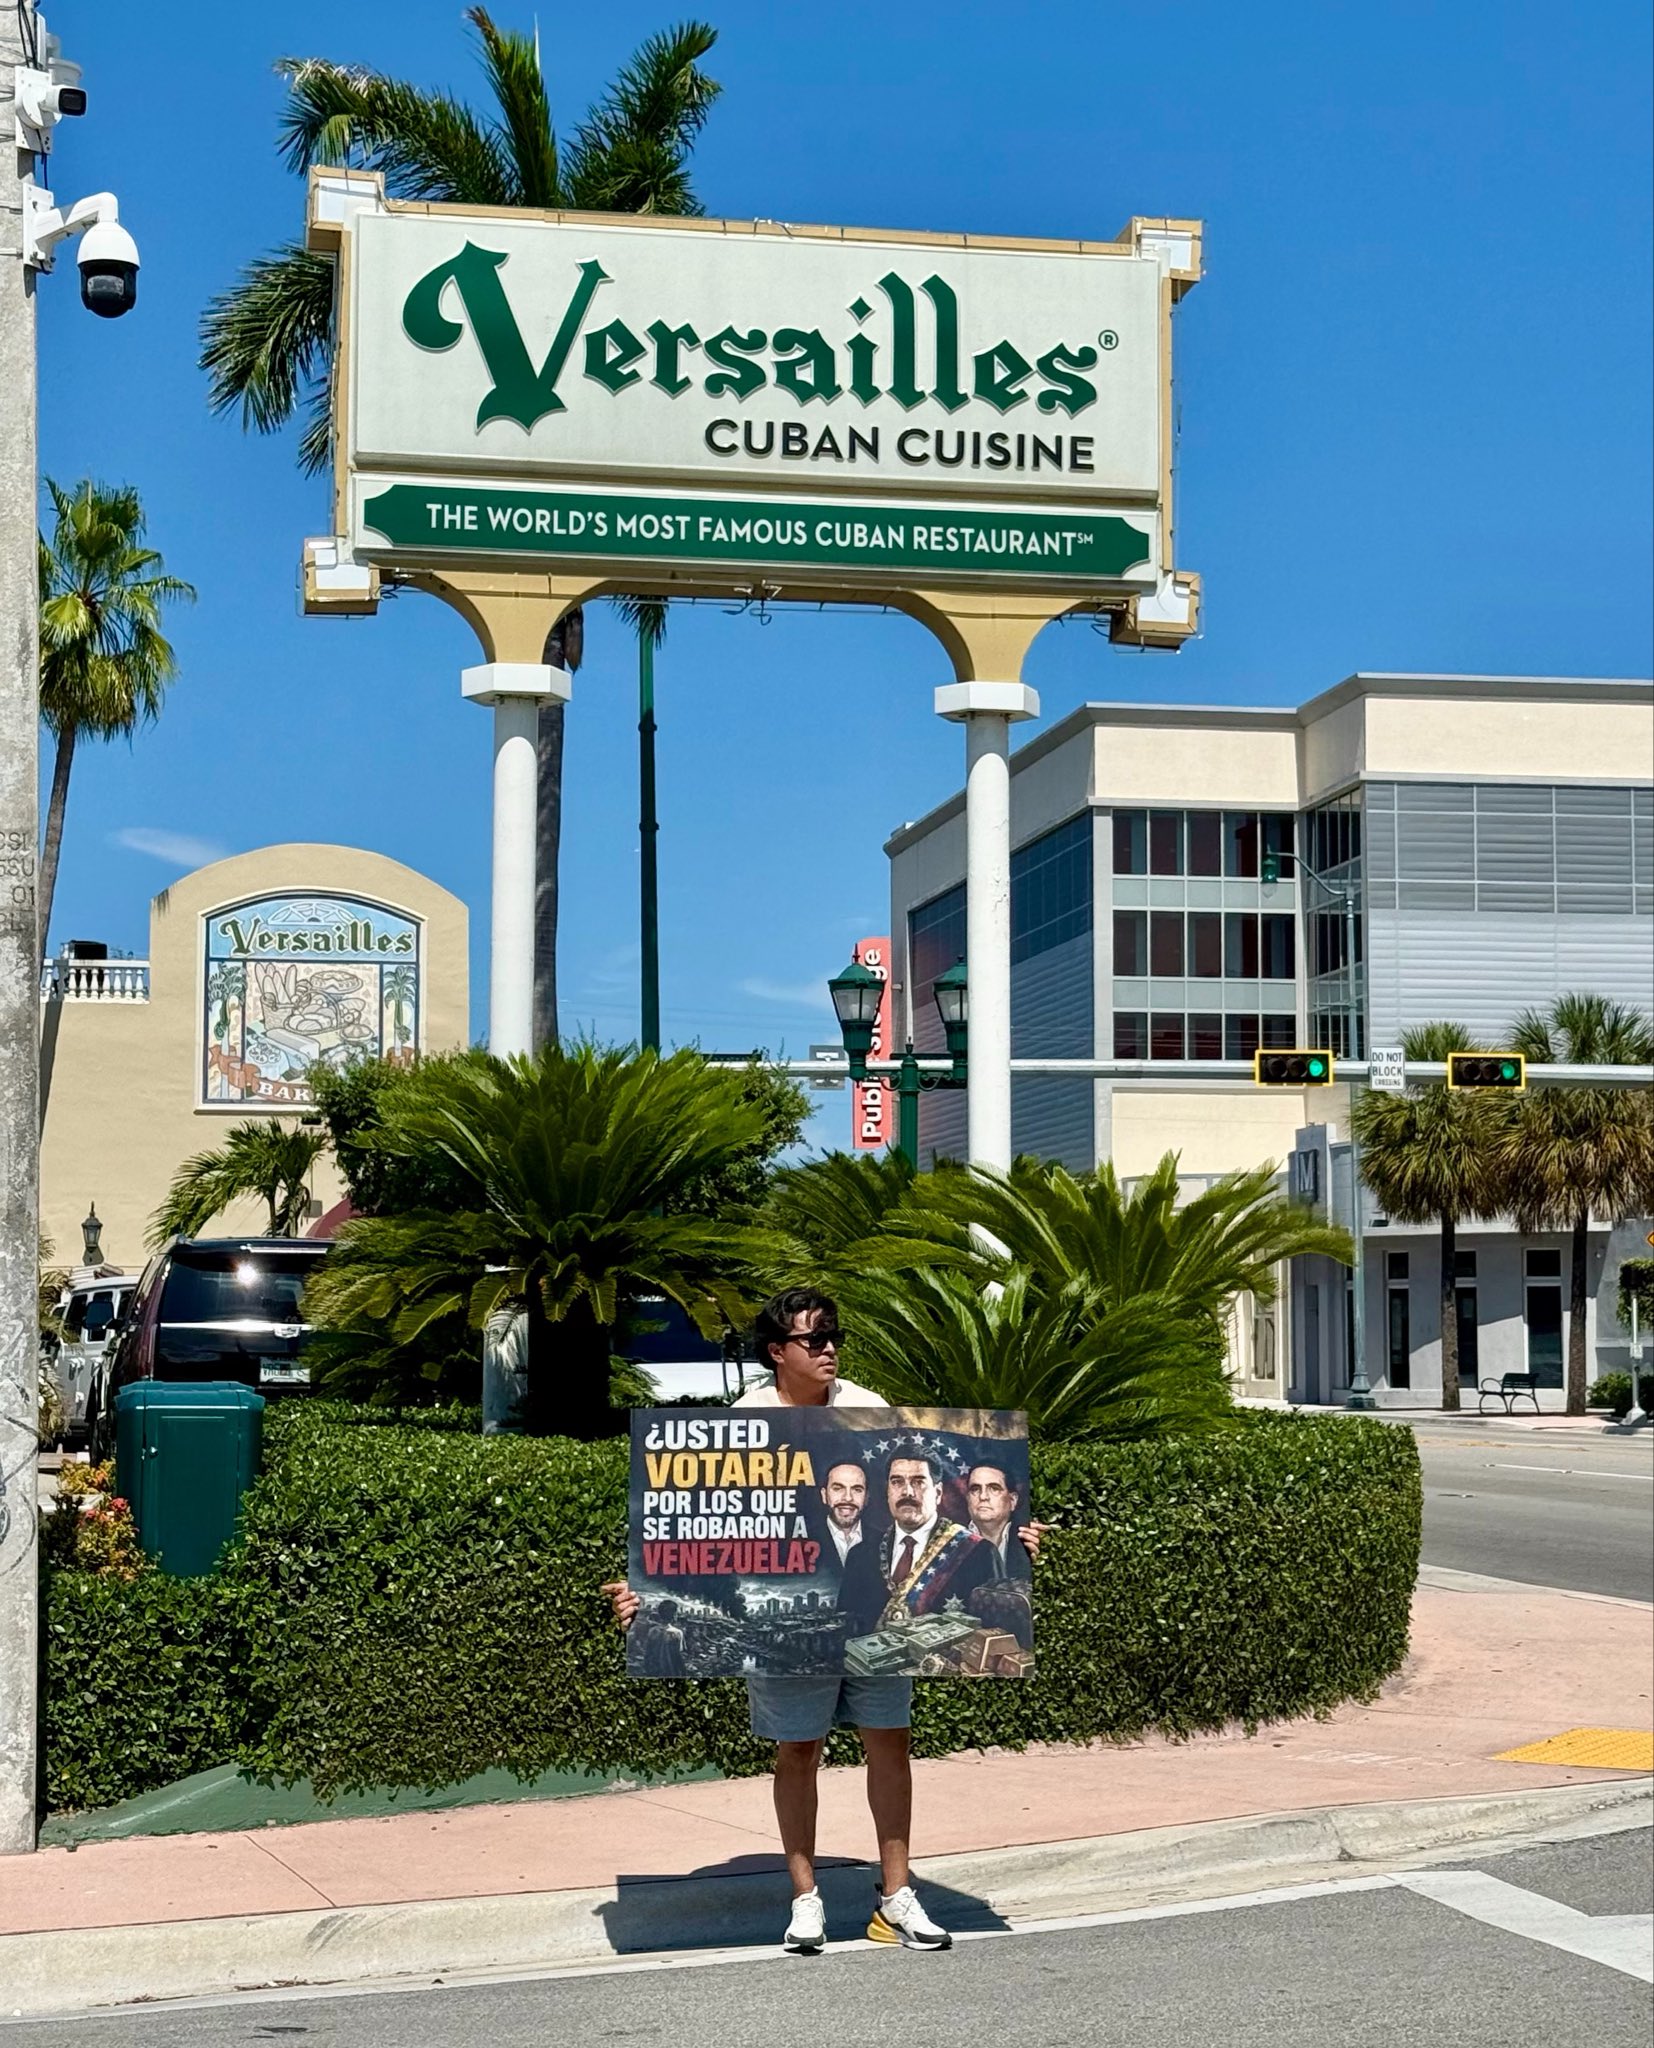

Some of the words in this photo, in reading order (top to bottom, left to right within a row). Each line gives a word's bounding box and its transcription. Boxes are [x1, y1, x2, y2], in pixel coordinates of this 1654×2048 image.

[402, 239, 1098, 435] Versailles
[704, 418, 880, 463] CUBAN
[897, 428, 1095, 473] CUISINE
[426, 503, 478, 530] THE
[487, 506, 608, 536] WORLD'S
[616, 513, 690, 540] MOST
[699, 516, 807, 545] FAMOUS
[815, 521, 904, 550] CUBAN
[219, 917, 414, 956] Versailles
[1372, 1052, 1383, 1062] DO
[1386, 1052, 1402, 1062] NOT
[1372, 1066, 1402, 1076] BLOCK
[257, 1081, 310, 1101] BAK
[861, 1056, 882, 1138] Publ
[644, 1419, 770, 1450] ¿USTED
[644, 1443, 817, 1489] VOTARÍA
[643, 1491, 692, 1515] POR
[699, 1490, 743, 1515] LOS
[751, 1489, 797, 1516] QUE
[643, 1517, 671, 1541] SE
[792, 1516, 809, 1539] A
[642, 1540, 821, 1576] VENEZUELA?
